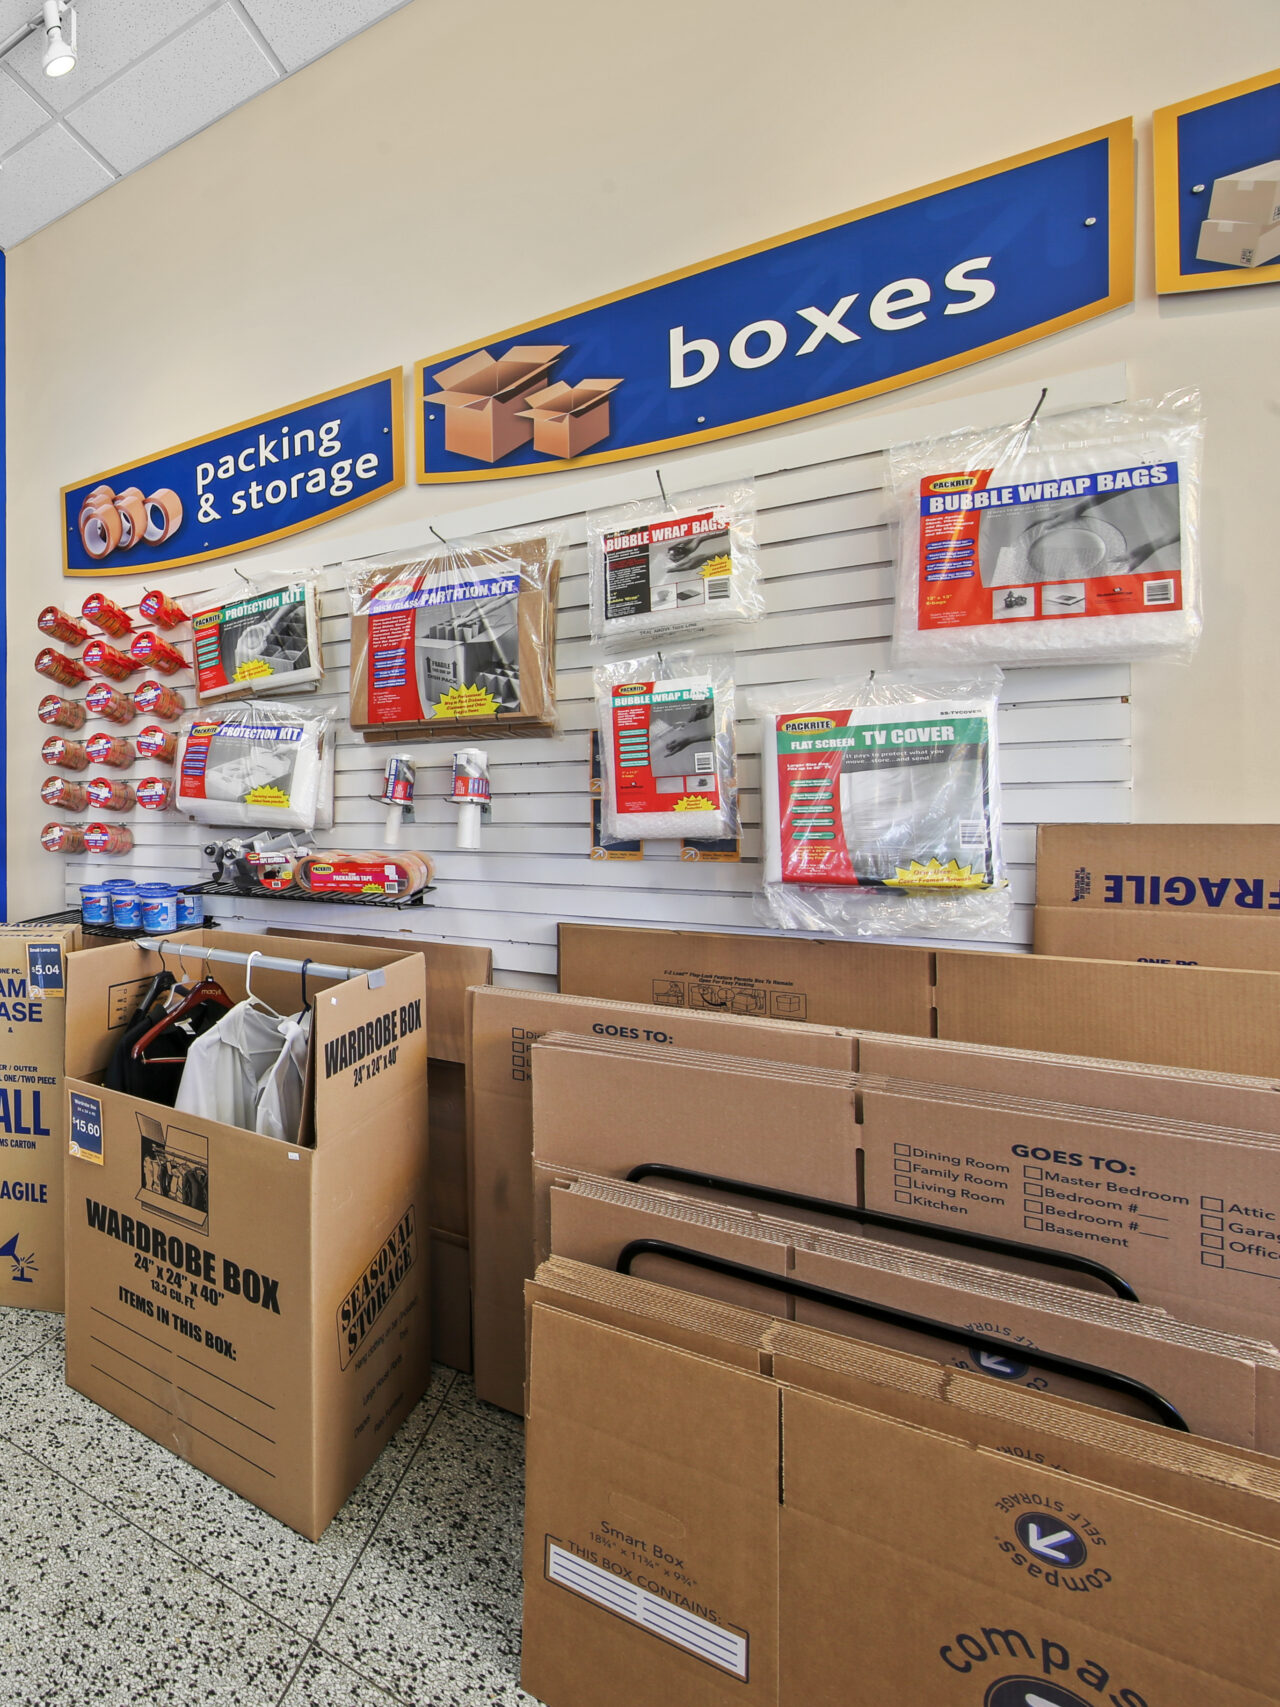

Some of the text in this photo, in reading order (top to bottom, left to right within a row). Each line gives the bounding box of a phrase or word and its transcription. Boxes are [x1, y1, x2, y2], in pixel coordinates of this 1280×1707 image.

[668, 257, 996, 388] boxes
[196, 419, 341, 495] packing
[197, 452, 378, 523] & storage
[929, 466, 1168, 514] BUBBLE WRAP BAGS
[606, 532, 649, 552] BUBBLE
[652, 523, 690, 542] WRAP
[225, 586, 304, 621] PROTECTION KIT
[422, 584, 488, 605] PARTITION
[491, 580, 515, 594] KIT
[614, 694, 649, 707] BUBBLE
[650, 692, 678, 704] WRAP
[221, 725, 301, 741] PROTECTION KIT
[785, 720, 831, 732] PACKRITE
[791, 726, 954, 750] FLAT SCREEN TV COVER
[32, 965, 59, 975] $5.04
[324, 998, 422, 1079] WARDROBE BOX
[592, 1023, 673, 1044] GOES TO:
[38, 1076, 56, 1085] PIECE
[73, 1117, 100, 1137] $15.60
[10, 1139, 36, 1149] CARTON
[913, 1147, 1010, 1174] Dining Room
[1011, 1144, 1137, 1177] GOES TO:
[913, 1163, 1009, 1190] Family Room
[1045, 1170, 1190, 1206] Master Bedroom
[913, 1179, 1005, 1206] Living Room
[913, 1195, 968, 1215] Kitchen
[1045, 1188, 1123, 1211] Bedroom
[1045, 1205, 1123, 1228] Bedroom
[1228, 1203, 1276, 1221] Attic
[1046, 1222, 1129, 1248] Basement
[86, 1198, 281, 1315] WARDROBE BOX
[341, 1212, 415, 1332] SEASONAL
[348, 1242, 412, 1357] STORAGE
[119, 1286, 237, 1361] ITEMS IN THIS BOX:
[994, 1492, 1106, 1546] SELF STORAGE
[600, 1520, 684, 1569] Smart Box
[998, 1539, 1112, 1592] compass
[568, 1540, 722, 1625] THIS BOX CONTAINS:
